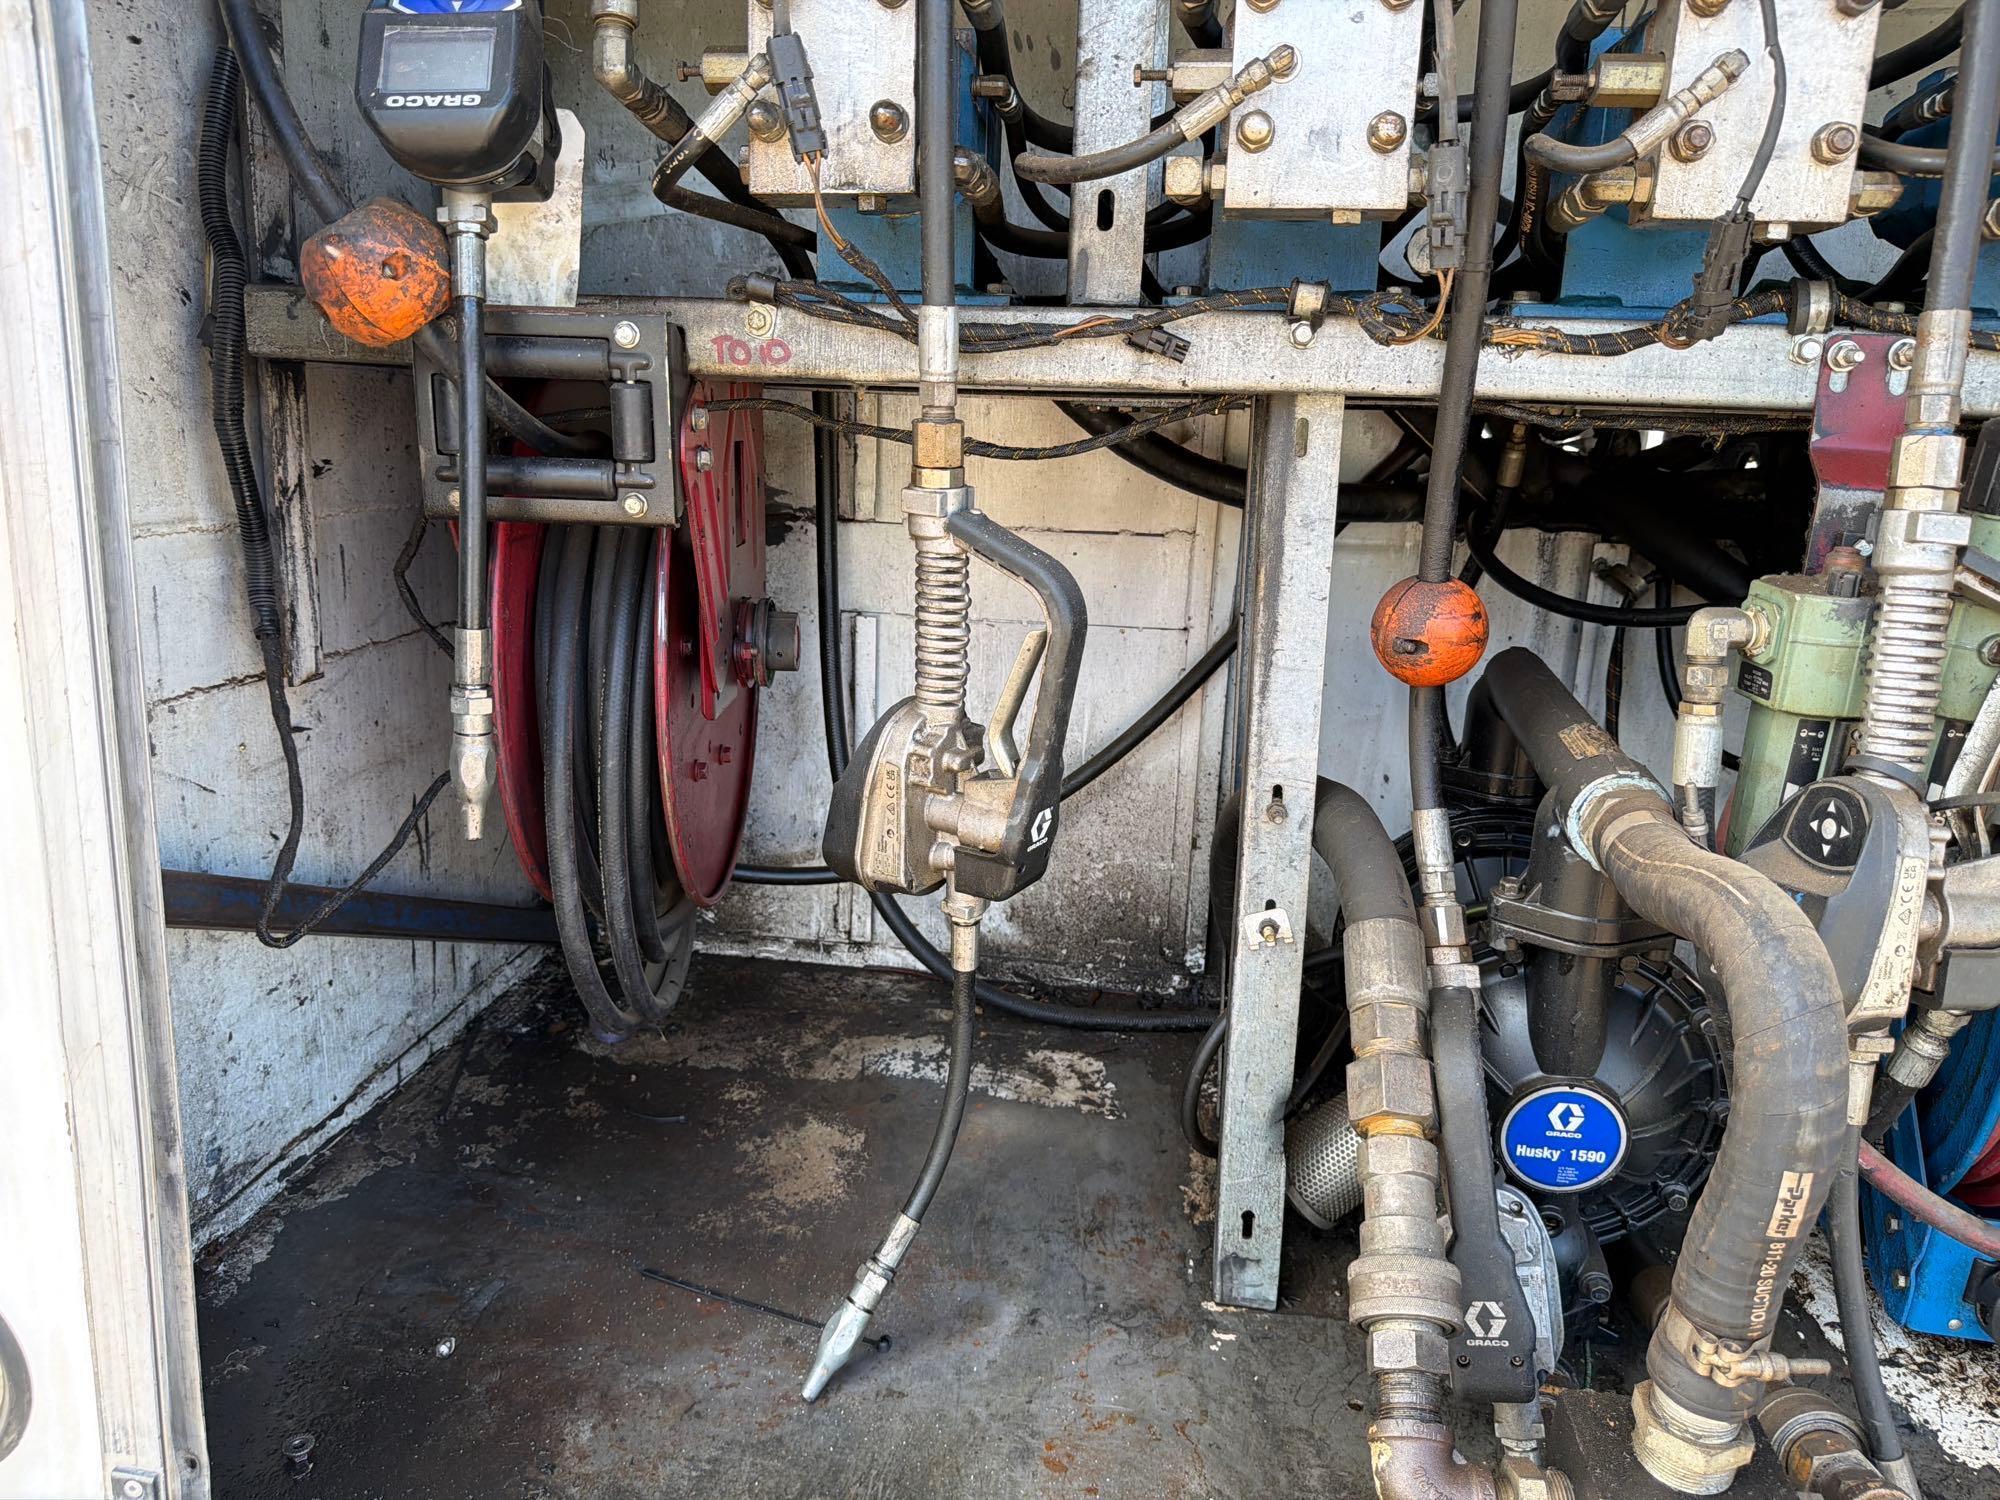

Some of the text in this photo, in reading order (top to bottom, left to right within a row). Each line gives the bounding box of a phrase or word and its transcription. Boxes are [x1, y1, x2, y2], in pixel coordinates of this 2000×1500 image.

[386, 94, 482, 107] GRACO
[1027, 837, 1048, 853] GRACO
[1545, 1130, 1582, 1139] GRACO
[1516, 1144, 1606, 1164] Husky 1590
[1774, 1184, 1805, 1236] Parker
[1759, 1242, 1786, 1277] 811-20
[1466, 1339, 1510, 1347] GRACO
